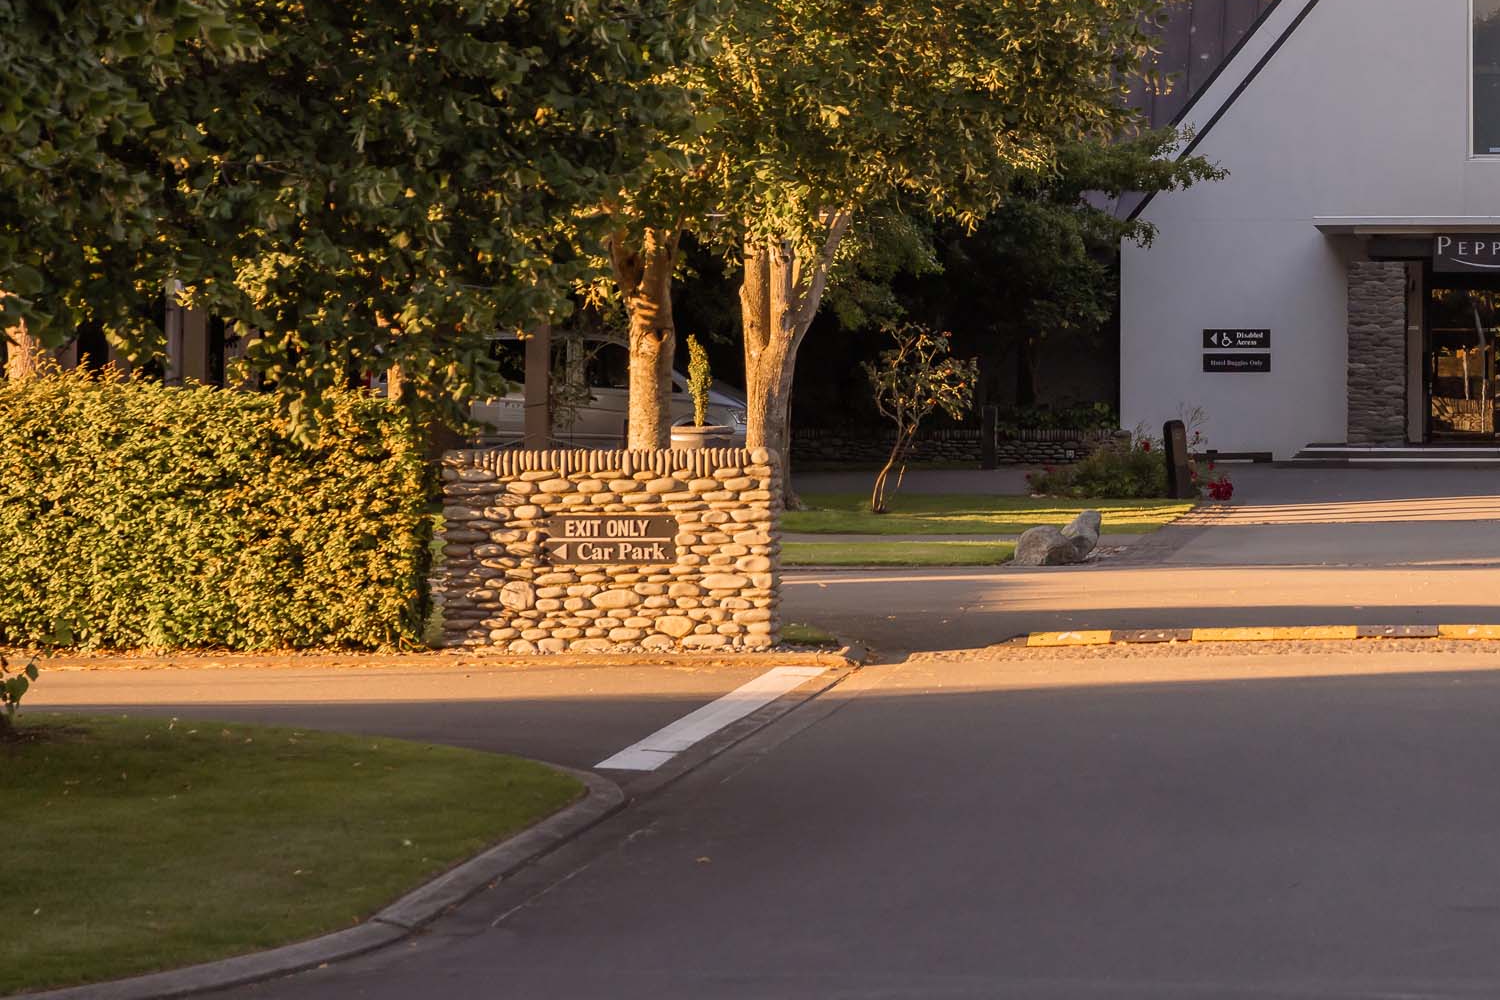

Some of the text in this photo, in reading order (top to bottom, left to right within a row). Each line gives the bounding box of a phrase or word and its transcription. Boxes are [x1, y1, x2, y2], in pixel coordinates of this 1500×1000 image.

[1236, 331, 1264, 339] Disabled
[564, 519, 650, 537] EXIT ONLY
[576, 542, 666, 560] Car Park
